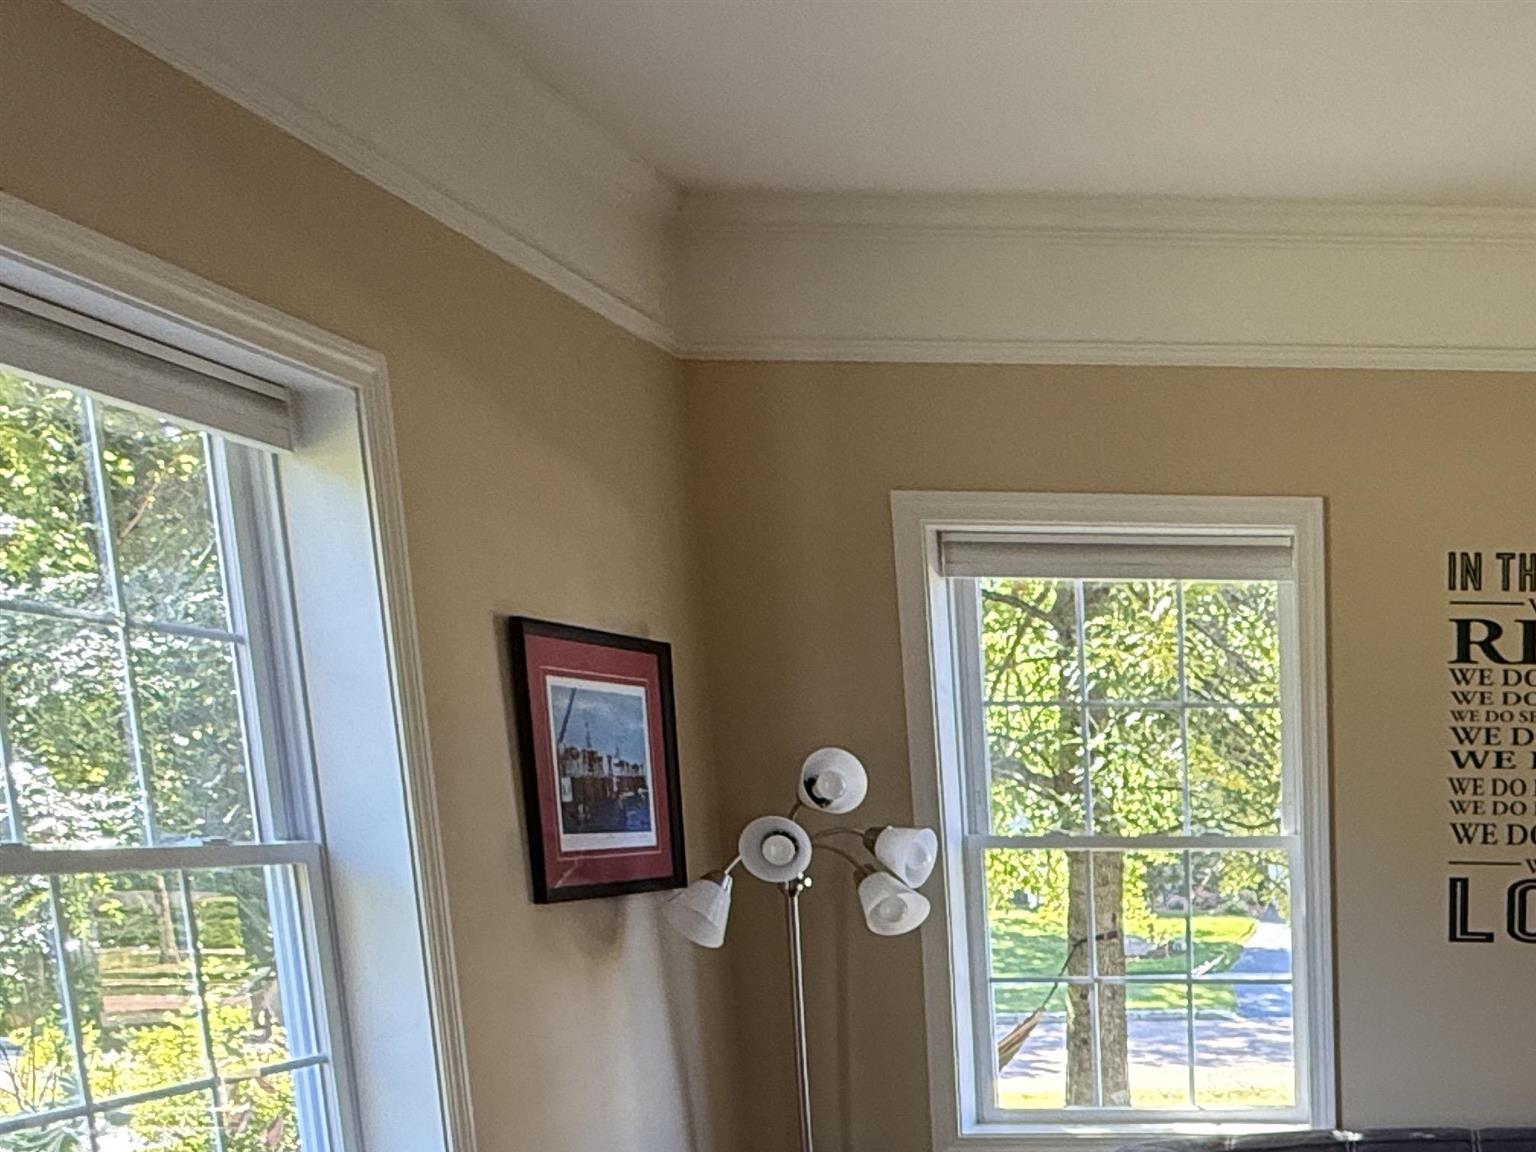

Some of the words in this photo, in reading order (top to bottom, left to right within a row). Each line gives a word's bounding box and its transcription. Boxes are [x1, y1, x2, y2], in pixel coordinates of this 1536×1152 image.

[1448, 551, 1482, 591] IN
[1449, 668, 1494, 687] WE
[1451, 691, 1494, 706] WE
[1450, 710, 1480, 723] WE
[1484, 710, 1515, 723] DO
[1450, 726, 1501, 746] WE
[1449, 751, 1517, 770] WE
[1448, 777, 1485, 797] WE
[1491, 778, 1527, 797] DO
[1448, 800, 1486, 815] WE
[1492, 800, 1527, 816] DO
[1449, 822, 1498, 845] WE
